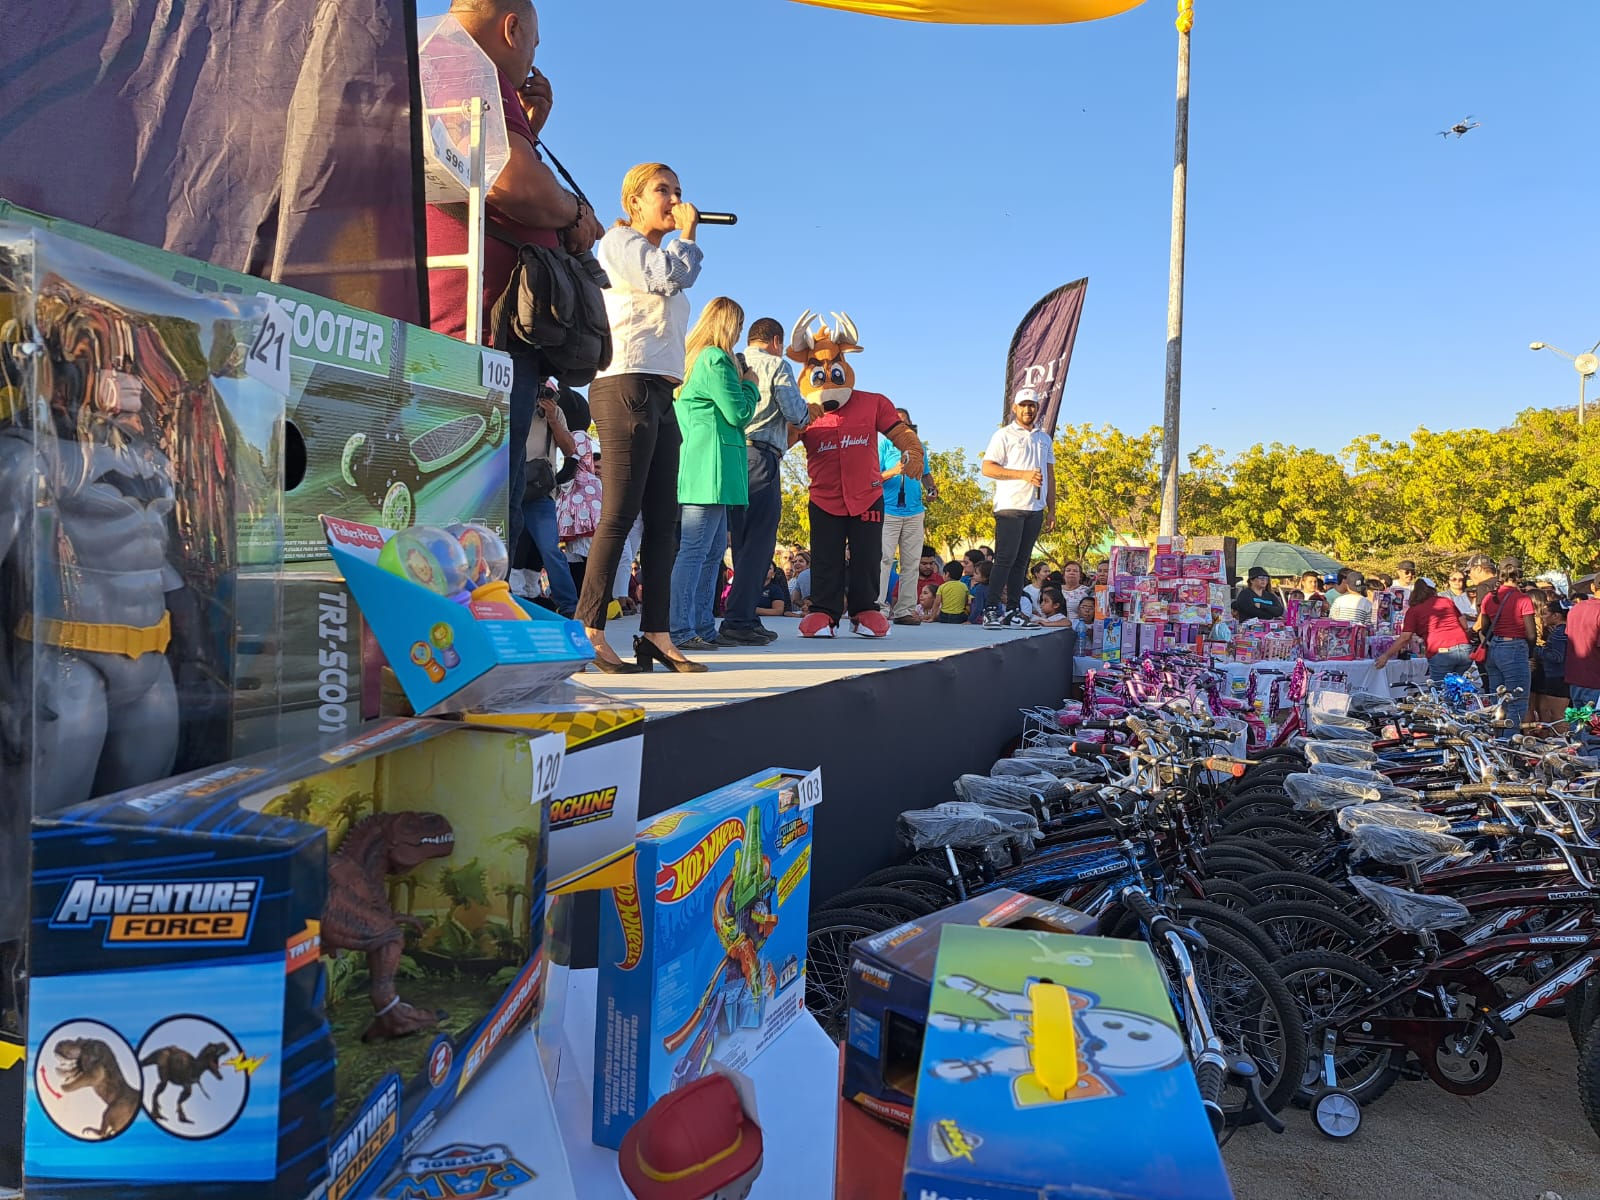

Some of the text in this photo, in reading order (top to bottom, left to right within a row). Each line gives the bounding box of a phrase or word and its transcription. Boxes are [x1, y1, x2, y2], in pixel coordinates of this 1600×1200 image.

[249, 311, 285, 371] 121
[256, 291, 384, 365] OOTER
[487, 360, 511, 388] 105
[861, 511, 881, 523] 911
[331, 522, 380, 543] Fisher-Price
[537, 752, 560, 795] 120
[801, 778, 819, 804] 103
[56, 879, 257, 922] ADVENTURE
[123, 917, 234, 937] FORCE
[288, 939, 312, 960] TRY
[435, 1046, 447, 1075] 2
[891, 1107, 910, 1121] TRUCK
[418, 1153, 497, 1169] PATROL
[382, 1161, 537, 1200] PAW
